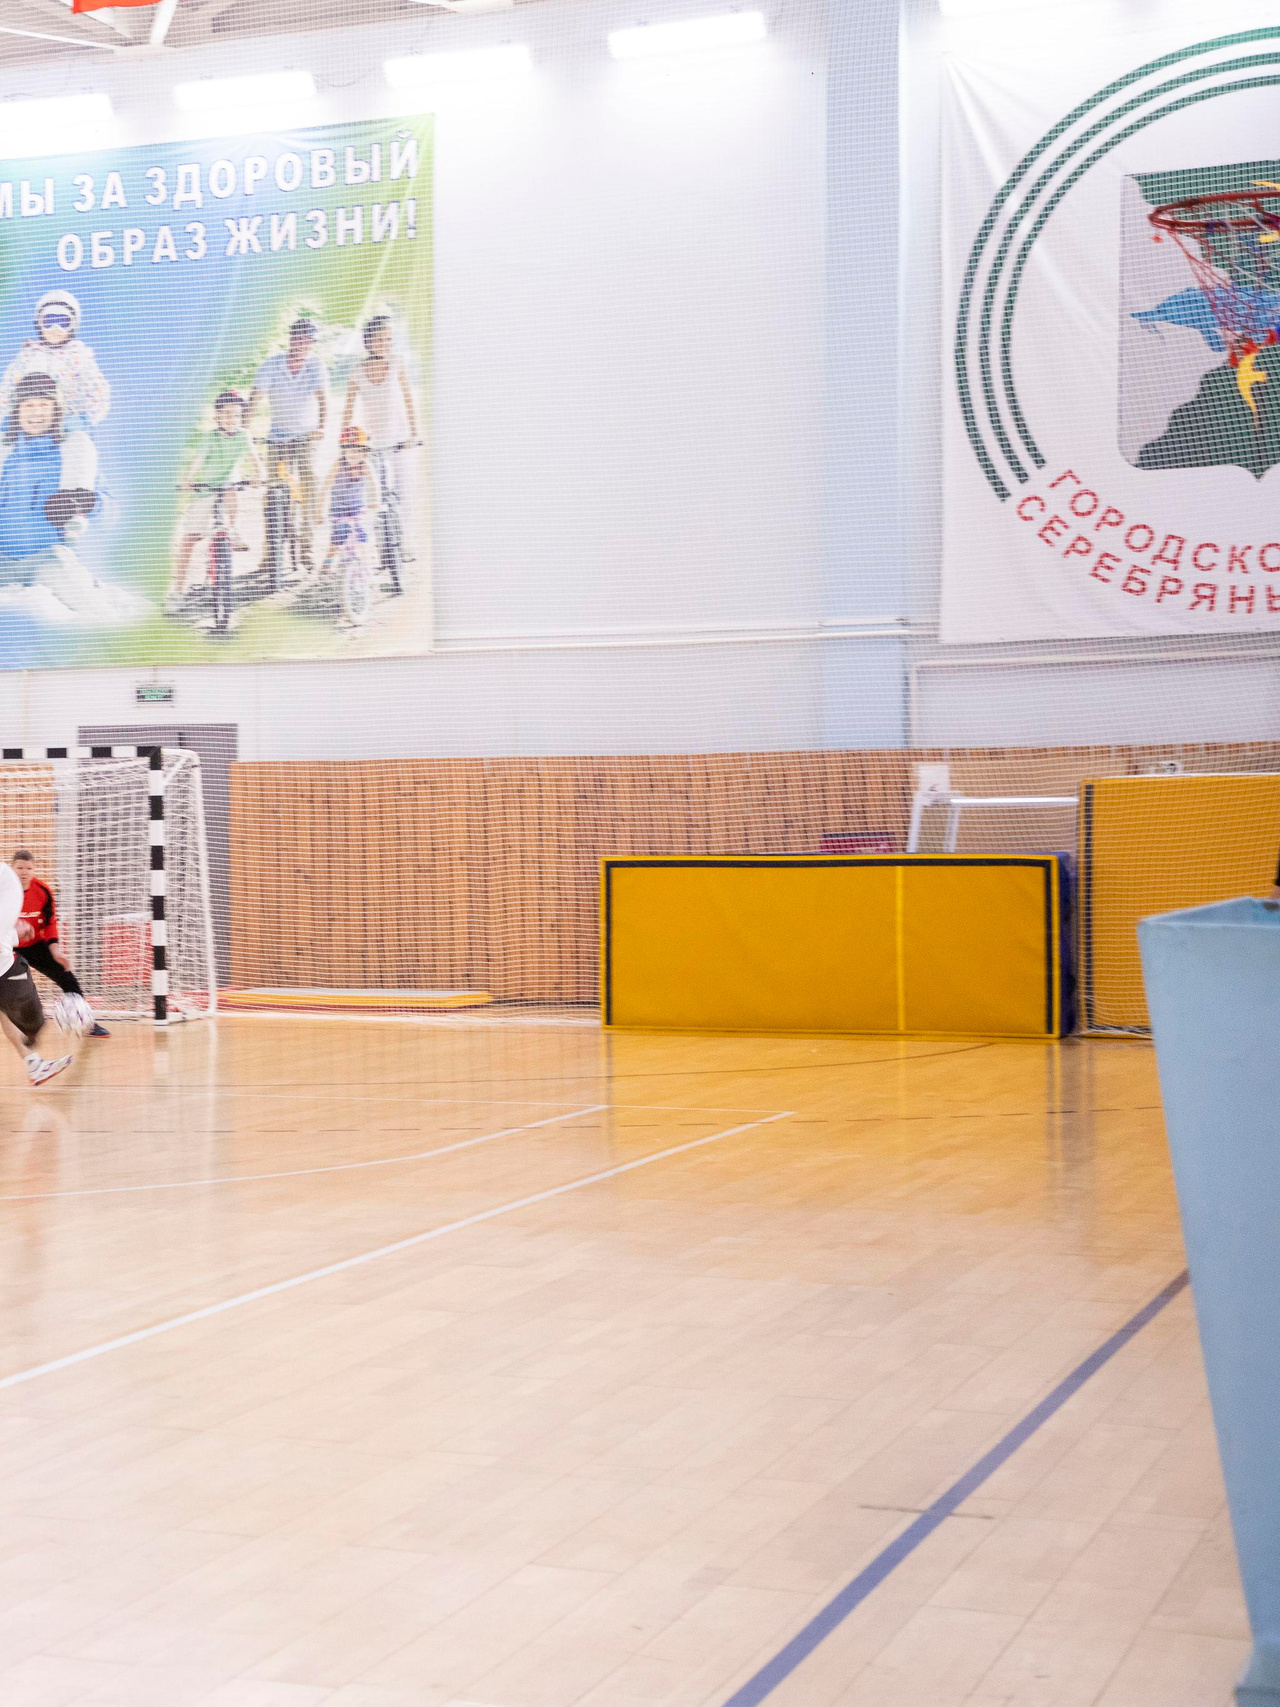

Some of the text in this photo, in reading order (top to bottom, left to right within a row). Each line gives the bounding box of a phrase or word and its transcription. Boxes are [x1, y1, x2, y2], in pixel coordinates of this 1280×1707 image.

[71, 171, 129, 213] ЗА
[144, 129, 419, 212] ЗДОРОВЫЙ
[55, 198, 418, 272] ОБРАЗ ЖИЗНИ!
[1048, 469, 1280, 574] ГОРОДСКО
